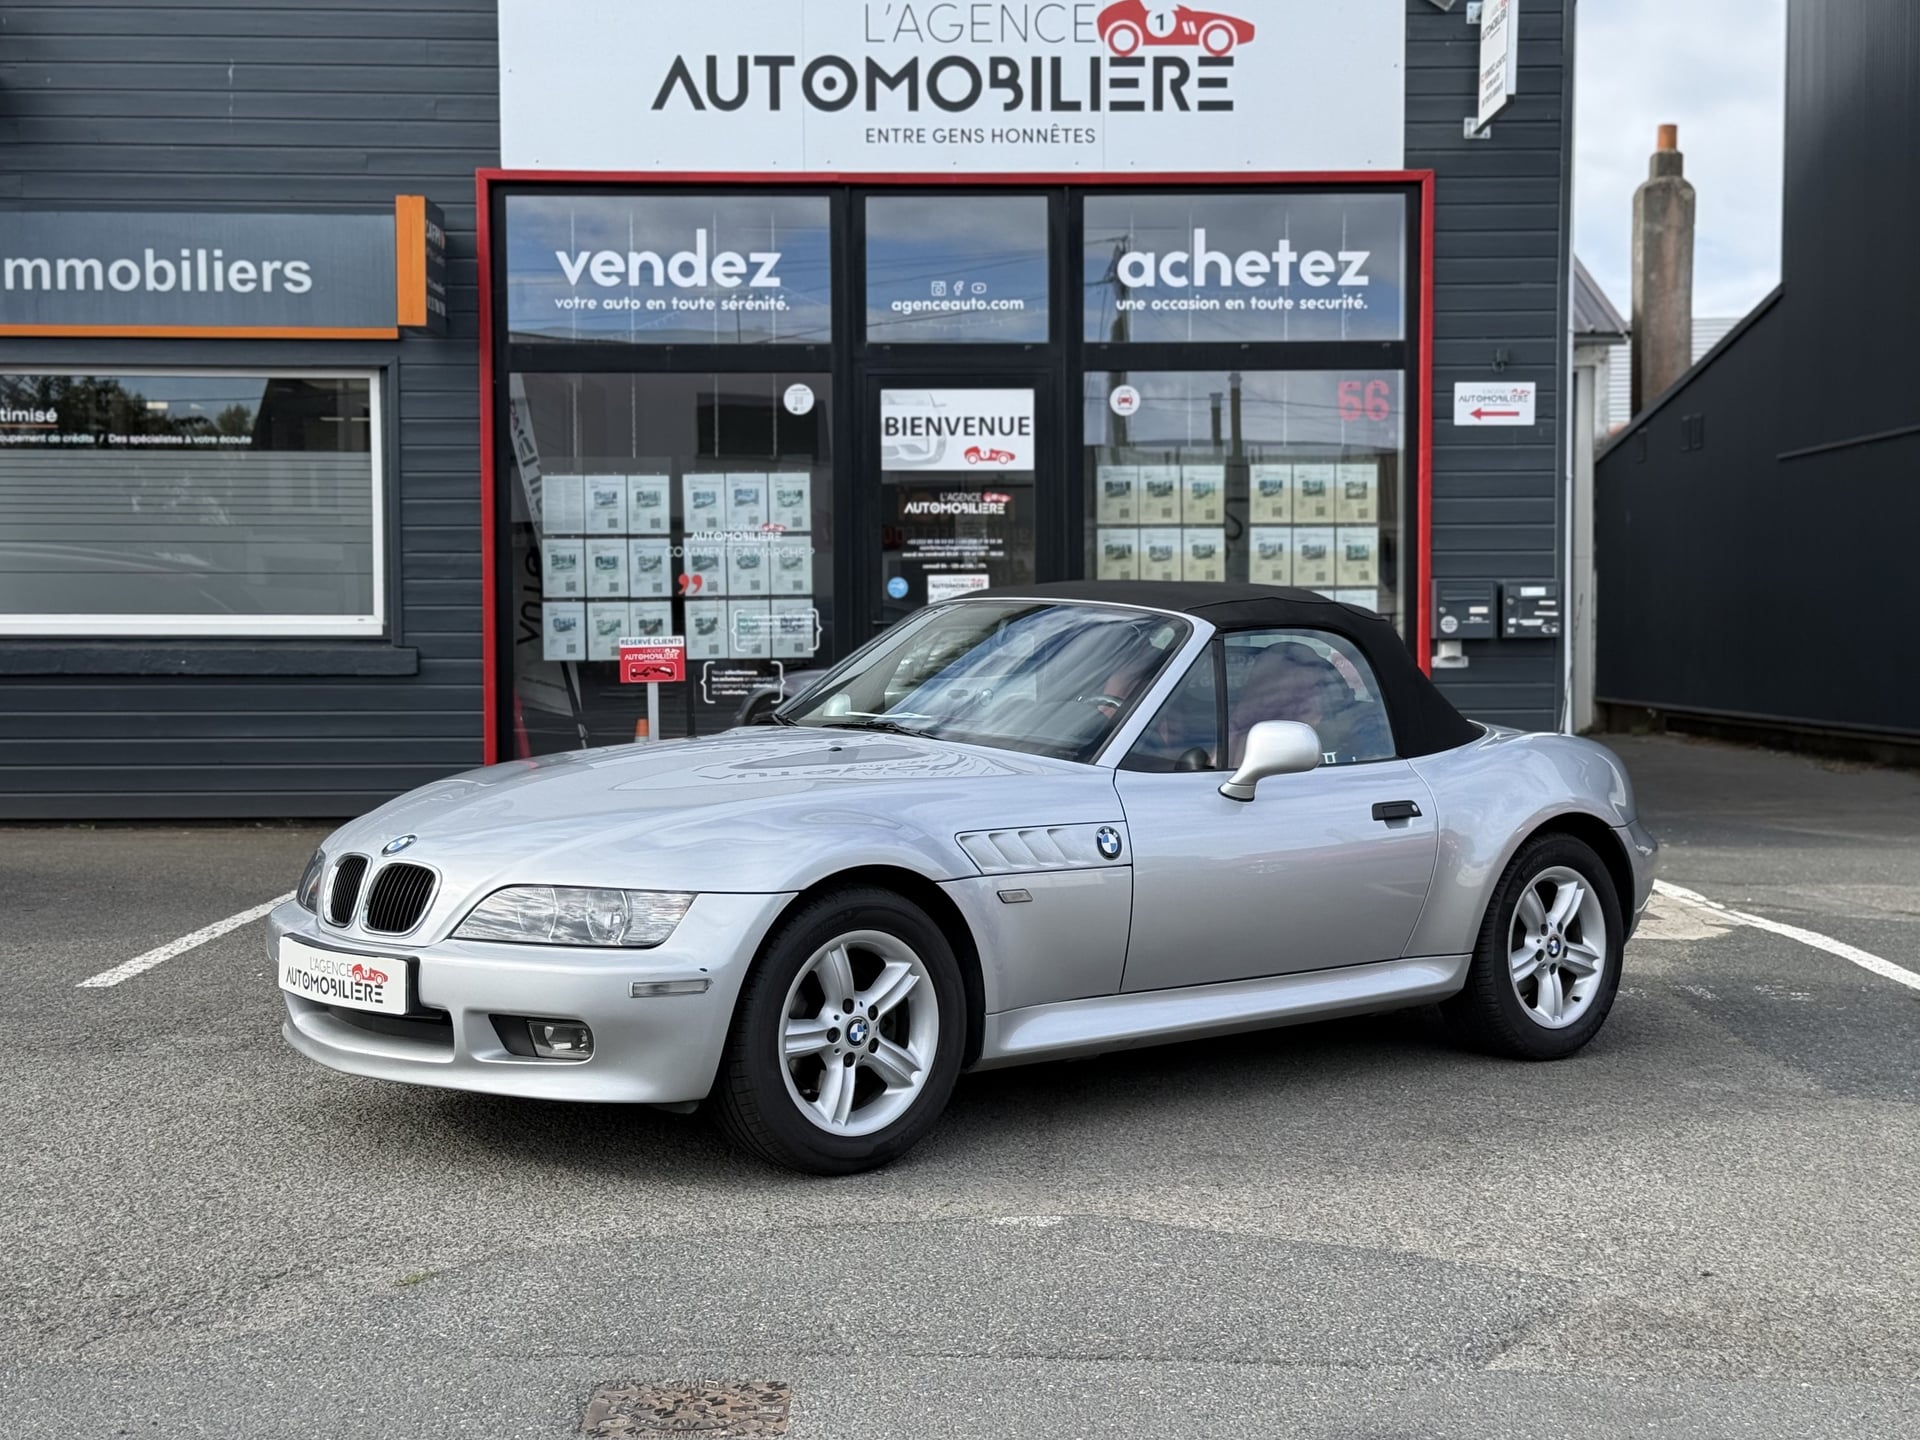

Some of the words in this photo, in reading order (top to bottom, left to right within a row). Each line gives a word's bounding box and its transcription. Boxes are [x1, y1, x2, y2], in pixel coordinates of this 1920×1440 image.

[865, 3, 1096, 43] L'AGENCE
[651, 54, 1234, 112] AUTOMOBILIERE
[865, 128, 926, 143] ENTRE
[932, 128, 985, 143] GENS
[991, 123, 1096, 143] HONNÊTES
[555, 228, 782, 288] vendez
[1117, 228, 1371, 288] achetez
[4, 248, 313, 294] mmobiliers
[555, 296, 597, 310] votre
[603, 296, 641, 310] auto
[646, 300, 666, 310] en
[672, 296, 716, 310] toute
[721, 295, 790, 311] sérénité.
[891, 298, 1024, 315] agenceauto.com
[1116, 300, 1146, 310] une
[1151, 295, 1220, 310] occasion
[1225, 300, 1245, 310] en
[1250, 296, 1294, 310] toute
[1299, 293, 1368, 310] securité.
[0, 407, 58, 422] timisé
[884, 416, 1031, 436] BIENVENUE
[108, 433, 127, 443] Des
[310, 956, 352, 977] L'AGENCE
[286, 966, 384, 1004] AUTOMOBILIERE
